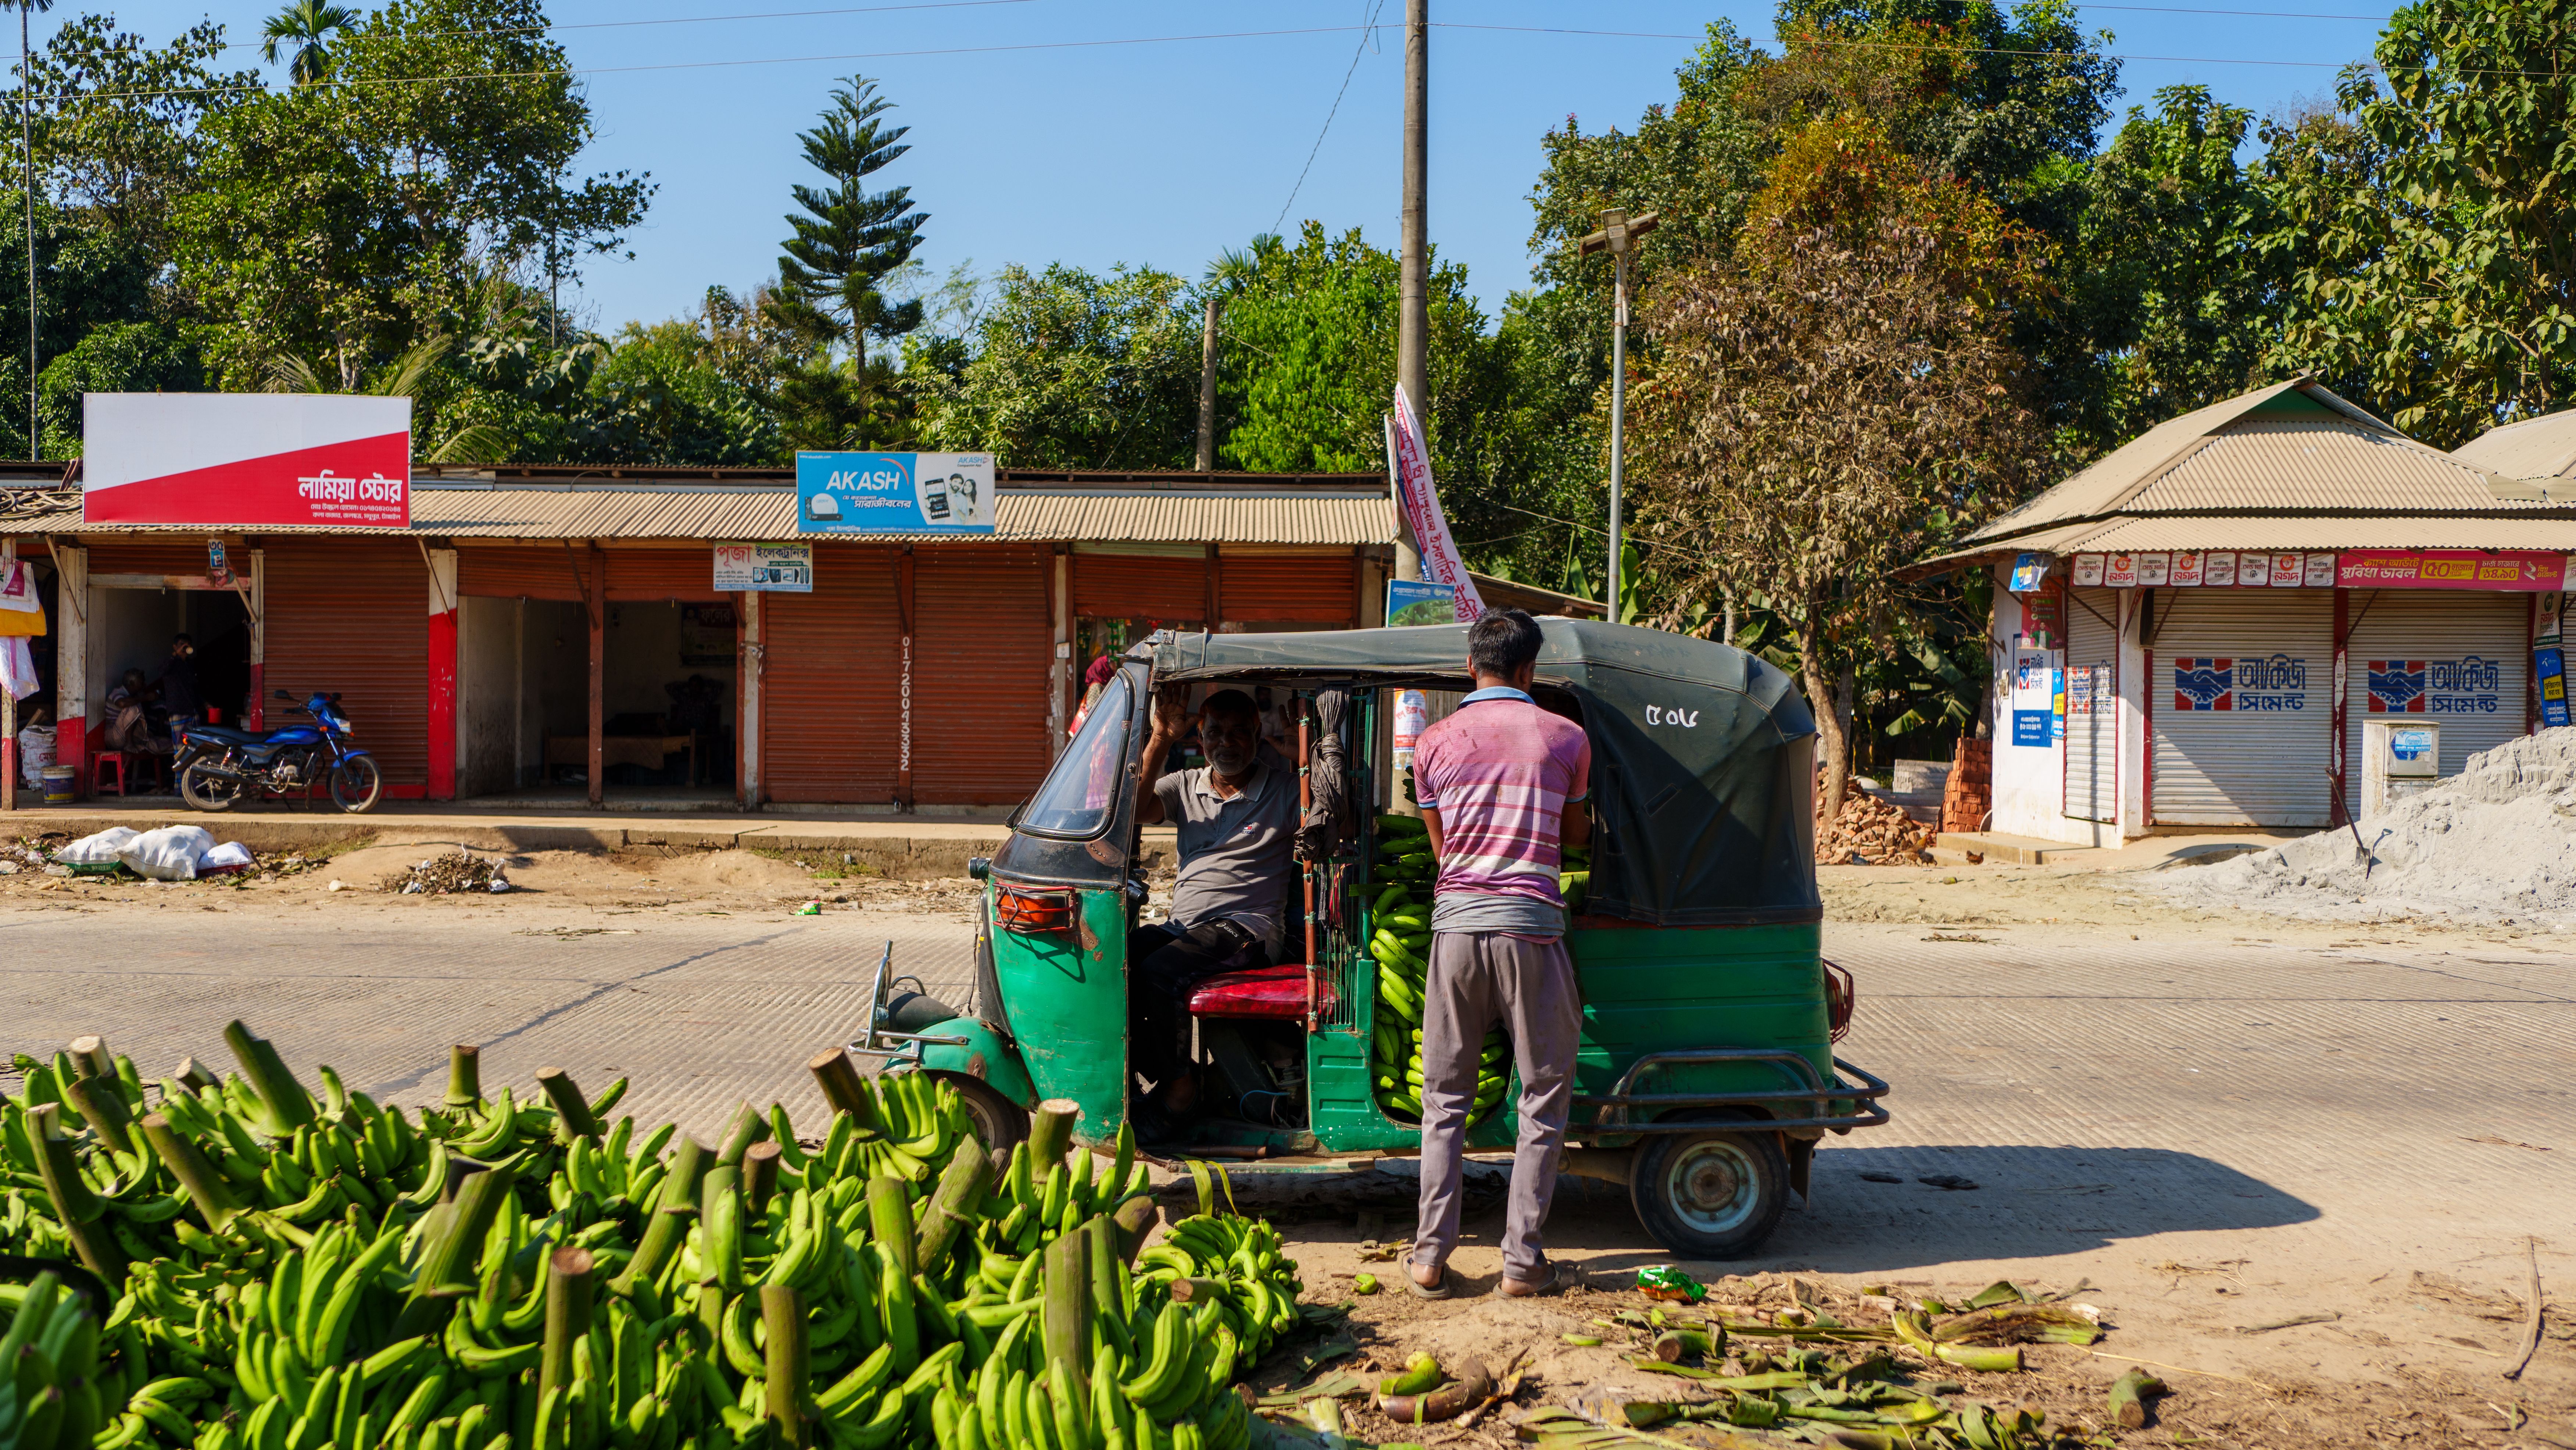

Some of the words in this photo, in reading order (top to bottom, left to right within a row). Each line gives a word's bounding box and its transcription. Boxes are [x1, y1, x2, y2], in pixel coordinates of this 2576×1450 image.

[298, 469, 356, 503] লামিয়া
[359, 472, 402, 504] স্টোর
[826, 471, 900, 491] AKASH
[854, 497, 912, 509] সারাজীবনের
[716, 544, 753, 569] পূজা
[2364, 558, 2387, 567] ক্যাশ
[2389, 557, 2420, 567] আউটে
[2482, 559, 2496, 567] চার্জ
[2109, 573, 2135, 581] নগদ
[2174, 572, 2199, 580] নগদ
[2274, 572, 2299, 581] নগদ
[2340, 564, 2379, 579] সুবিধা
[2380, 568, 2418, 579] ডাবল
[2524, 561, 2536, 581] ২
[700, 608, 731, 624] ফলের
[2540, 612, 2554, 624] নগদ
[2239, 654, 2305, 690] আকিজ
[2432, 655, 2499, 692] আকিজ
[900, 636, 911, 771] 01720043332
[2239, 692, 2305, 711] সিমেন্ট
[2431, 694, 2498, 712] সিমেন্ট
[1223, 926, 1239, 938] asics
